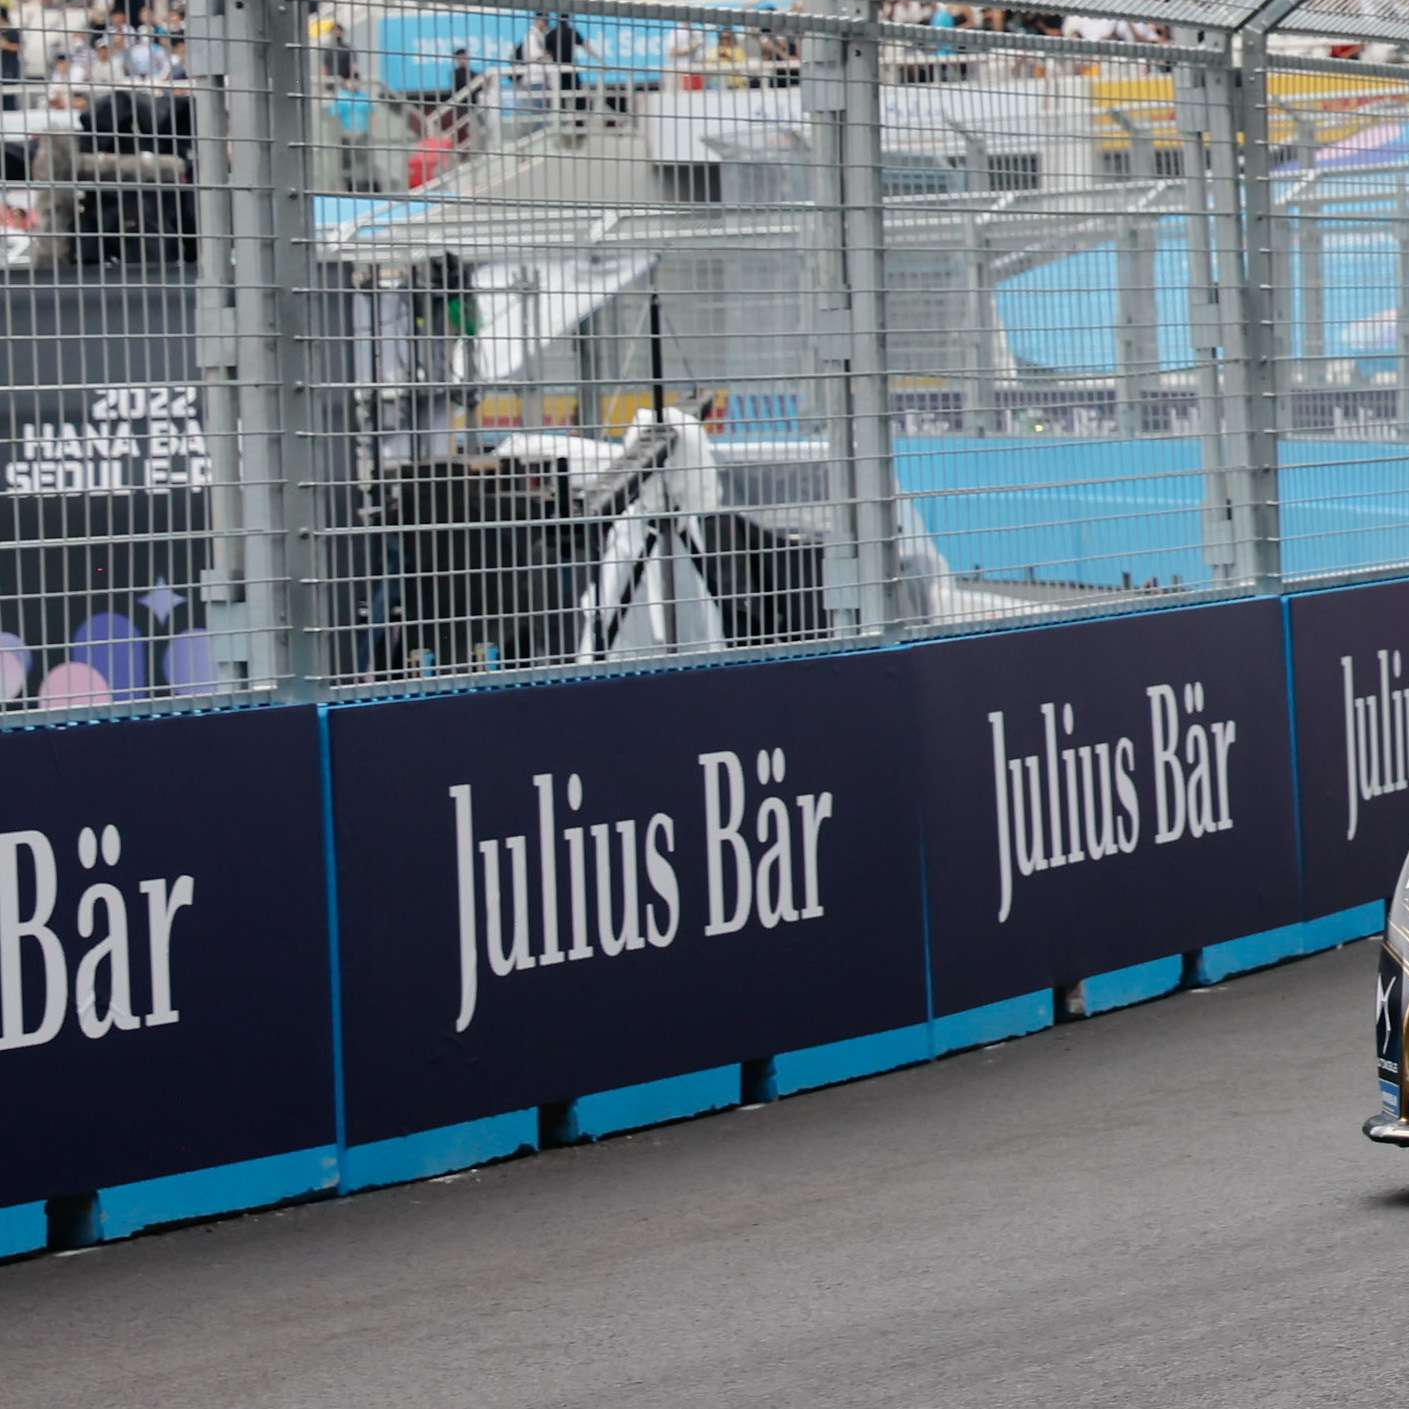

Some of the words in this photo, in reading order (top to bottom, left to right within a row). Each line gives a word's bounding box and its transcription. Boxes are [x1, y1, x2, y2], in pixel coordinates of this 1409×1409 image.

[23, 421, 140, 460] HANA
[92, 386, 197, 419] 2022
[6, 459, 137, 498] SEOUL
[987, 702, 1140, 924] Julius
[1146, 681, 1236, 844] Bär
[0, 824, 194, 1051] Bär
[449, 772, 680, 1033] Julius
[698, 747, 833, 937] Bär
